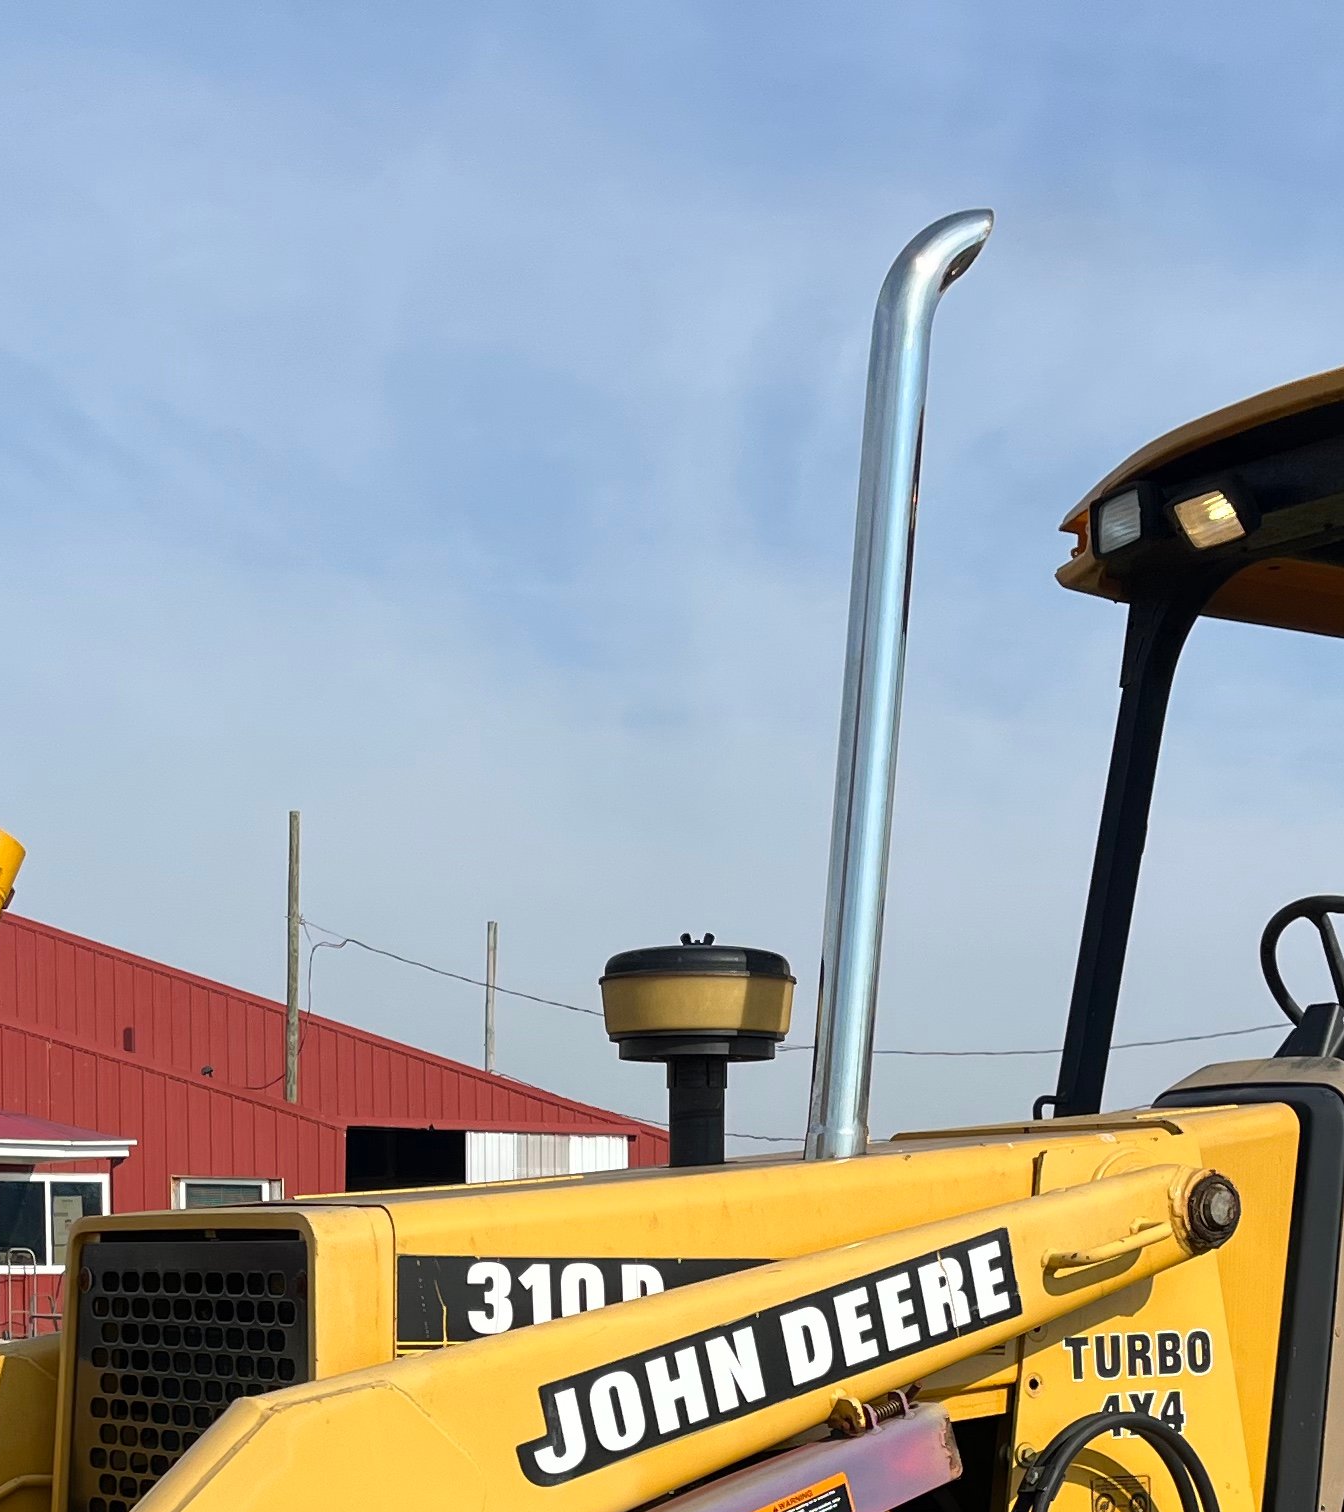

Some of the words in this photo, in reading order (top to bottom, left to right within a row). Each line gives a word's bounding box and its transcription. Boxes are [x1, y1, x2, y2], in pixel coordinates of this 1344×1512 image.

[534, 1325, 766, 1475] JOHN
[779, 1239, 1011, 1387] DEERE
[1063, 1329, 1212, 1381] TURBO
[1102, 1390, 1185, 1438] 4X4
[778, 1489, 814, 1510] WARNING
